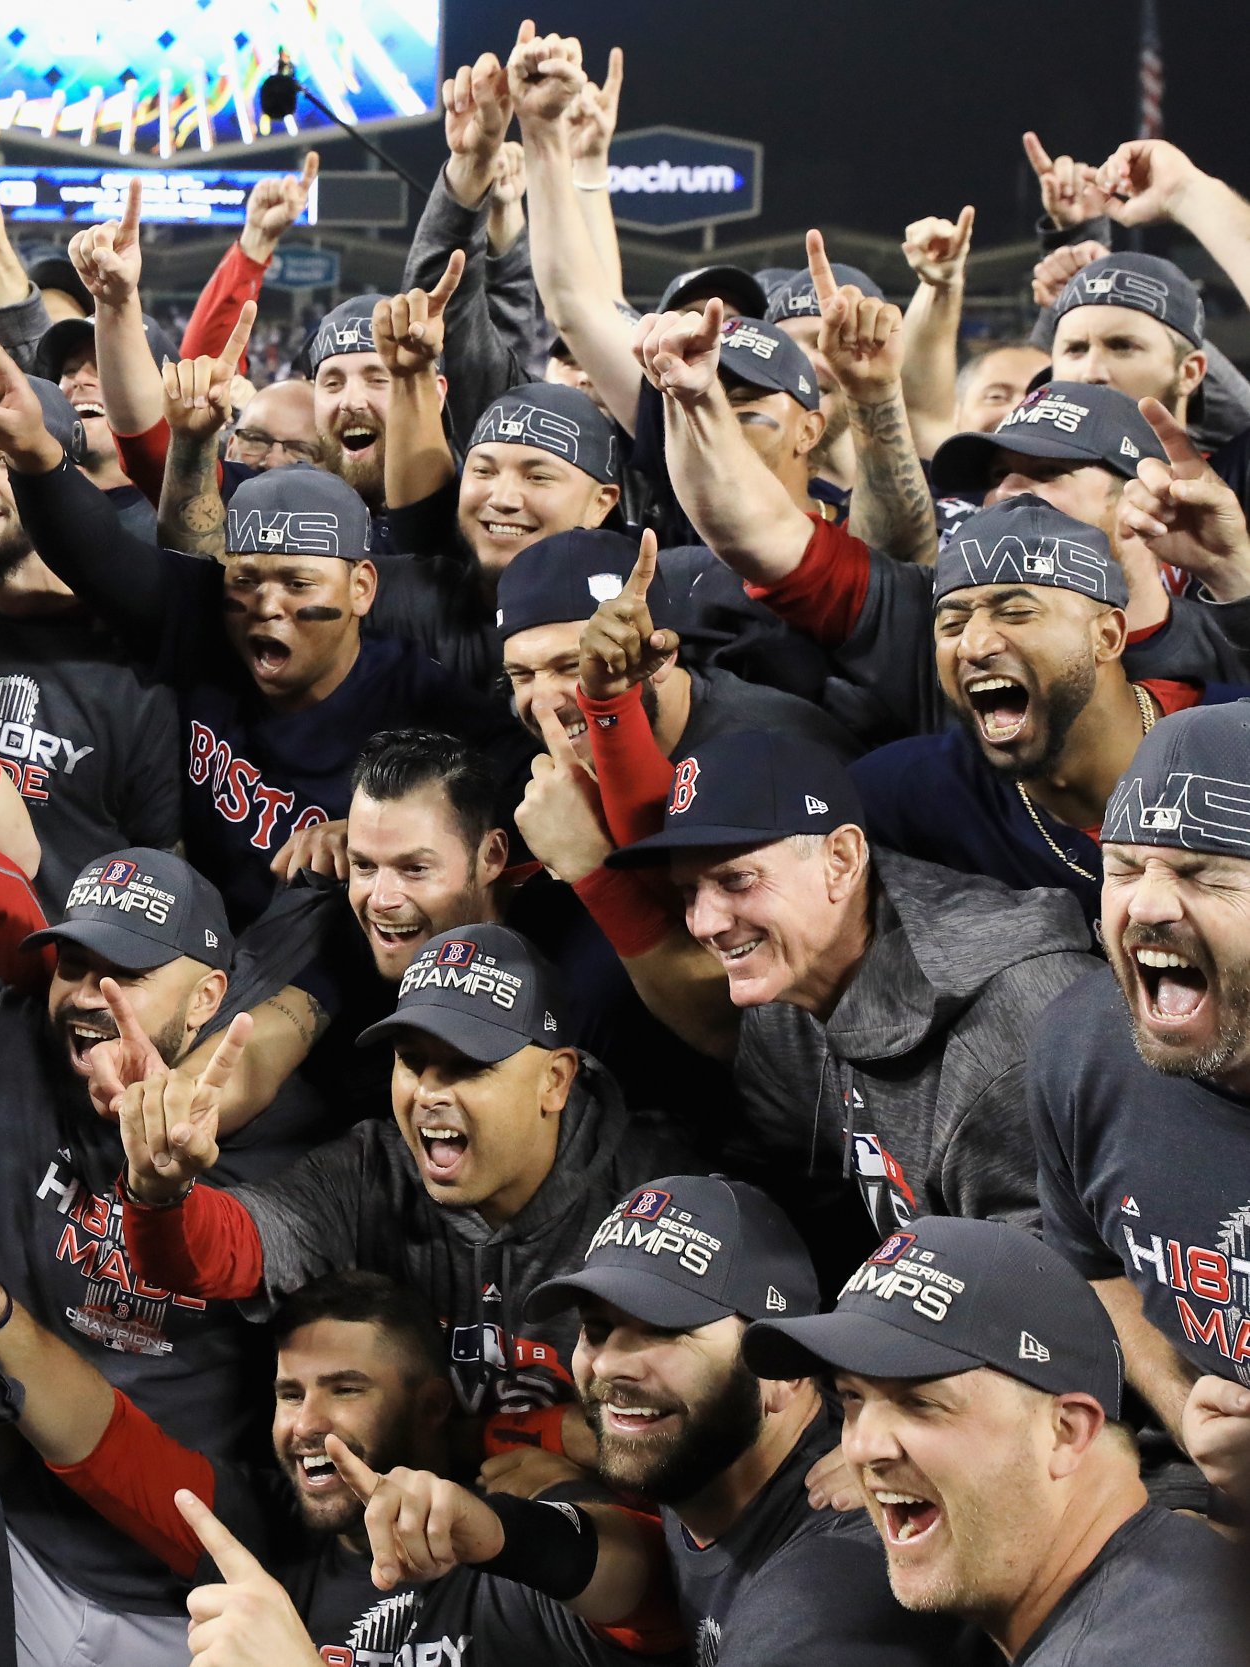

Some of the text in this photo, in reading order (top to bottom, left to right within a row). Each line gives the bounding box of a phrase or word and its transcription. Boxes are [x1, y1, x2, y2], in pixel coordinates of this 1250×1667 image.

[608, 160, 736, 194] pectrum
[995, 402, 1082, 434] AMPS
[228, 509, 338, 557] WS
[959, 535, 1108, 601] WS
[668, 757, 701, 816] B
[127, 881, 176, 906] SERIES
[136, 872, 154, 884] 18
[65, 885, 170, 926] CHAMPS
[469, 961, 523, 989] SERIES
[476, 953, 497, 966] 18
[398, 968, 518, 1010] CHAMPS
[668, 1206, 693, 1223] 18
[657, 1216, 722, 1252] SERIES
[907, 1246, 936, 1263] 18
[894, 1258, 966, 1295] SERIES
[516, 1344, 546, 1361] 18
